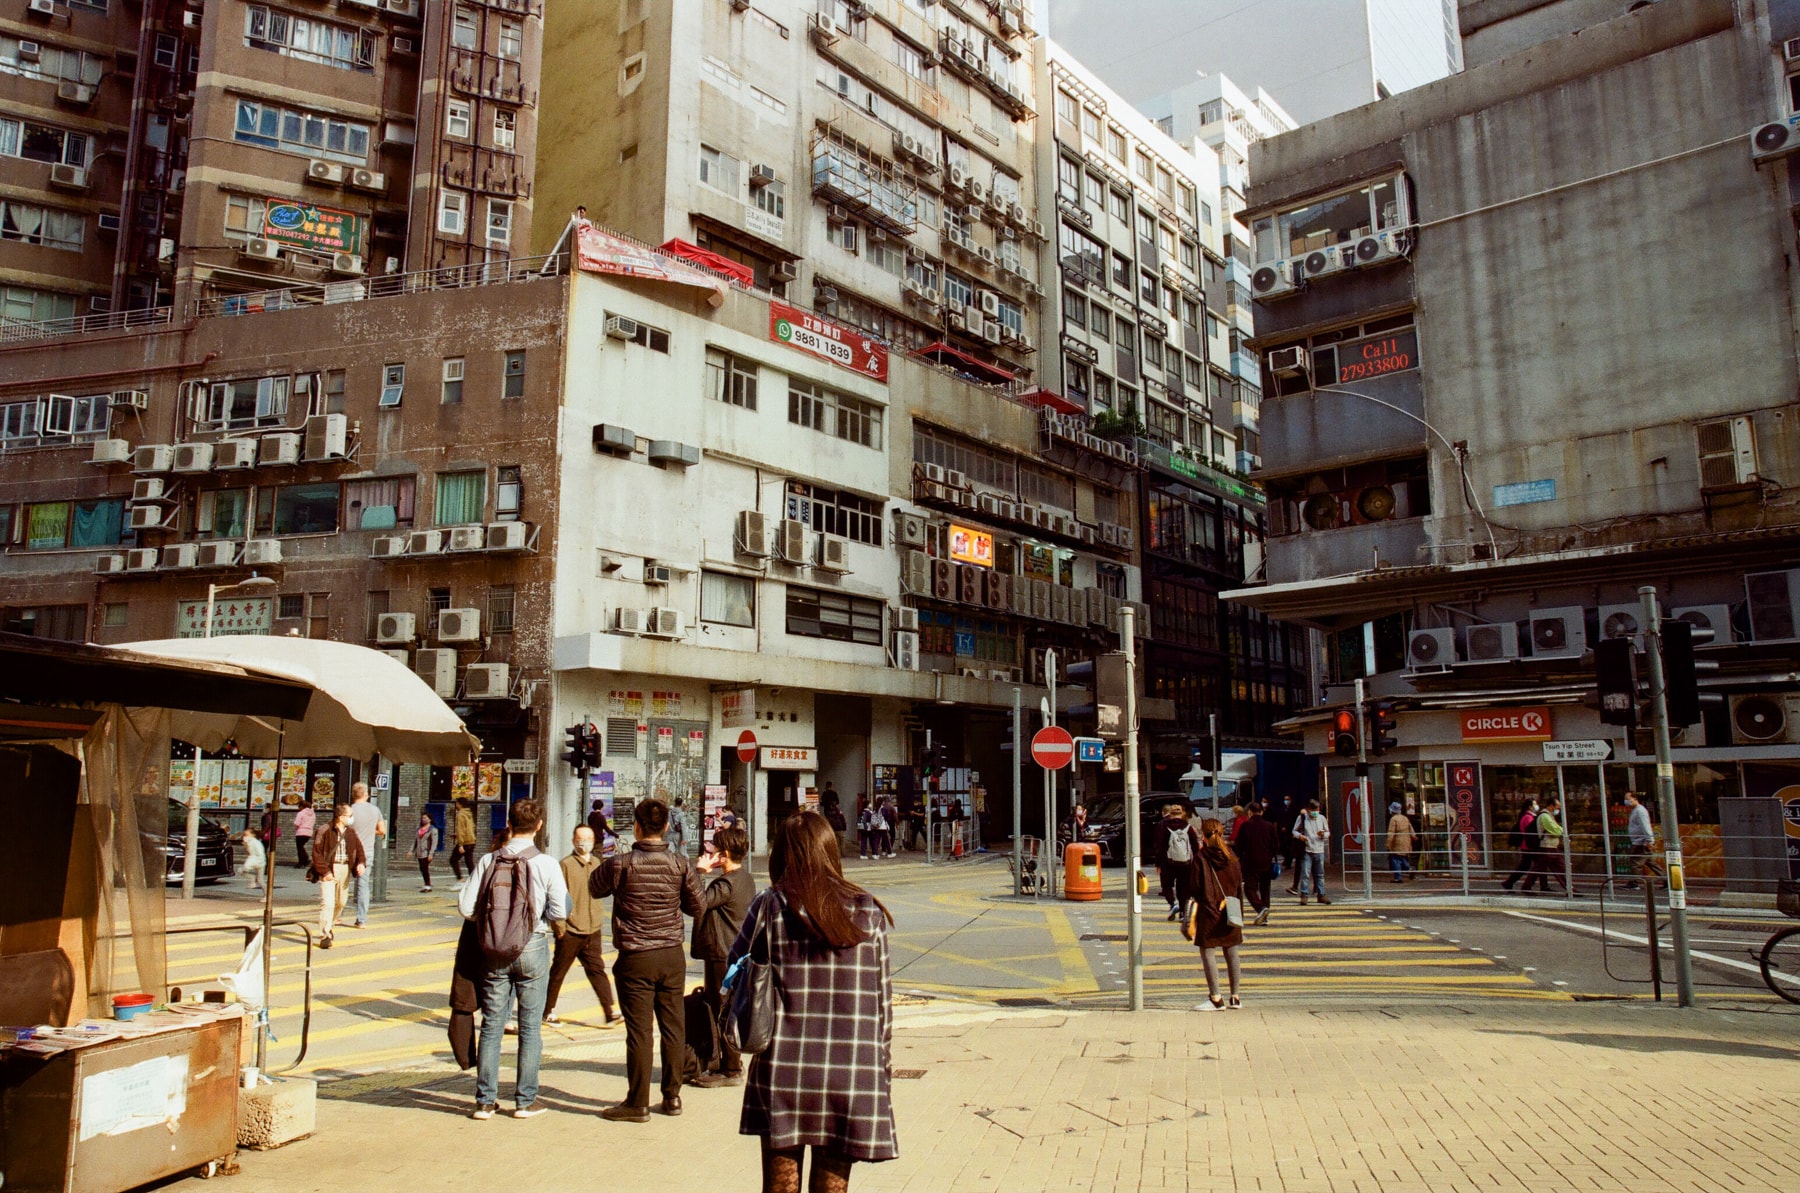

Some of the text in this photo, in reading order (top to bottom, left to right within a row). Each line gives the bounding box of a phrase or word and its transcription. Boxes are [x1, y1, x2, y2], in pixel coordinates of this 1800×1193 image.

[794, 330, 850, 360] 9881 1839
[1362, 338, 1397, 359] Call
[1341, 353, 1409, 382] 27933800
[1467, 712, 1543, 731] CIRCLE K
[770, 749, 808, 760] 好運來食堂
